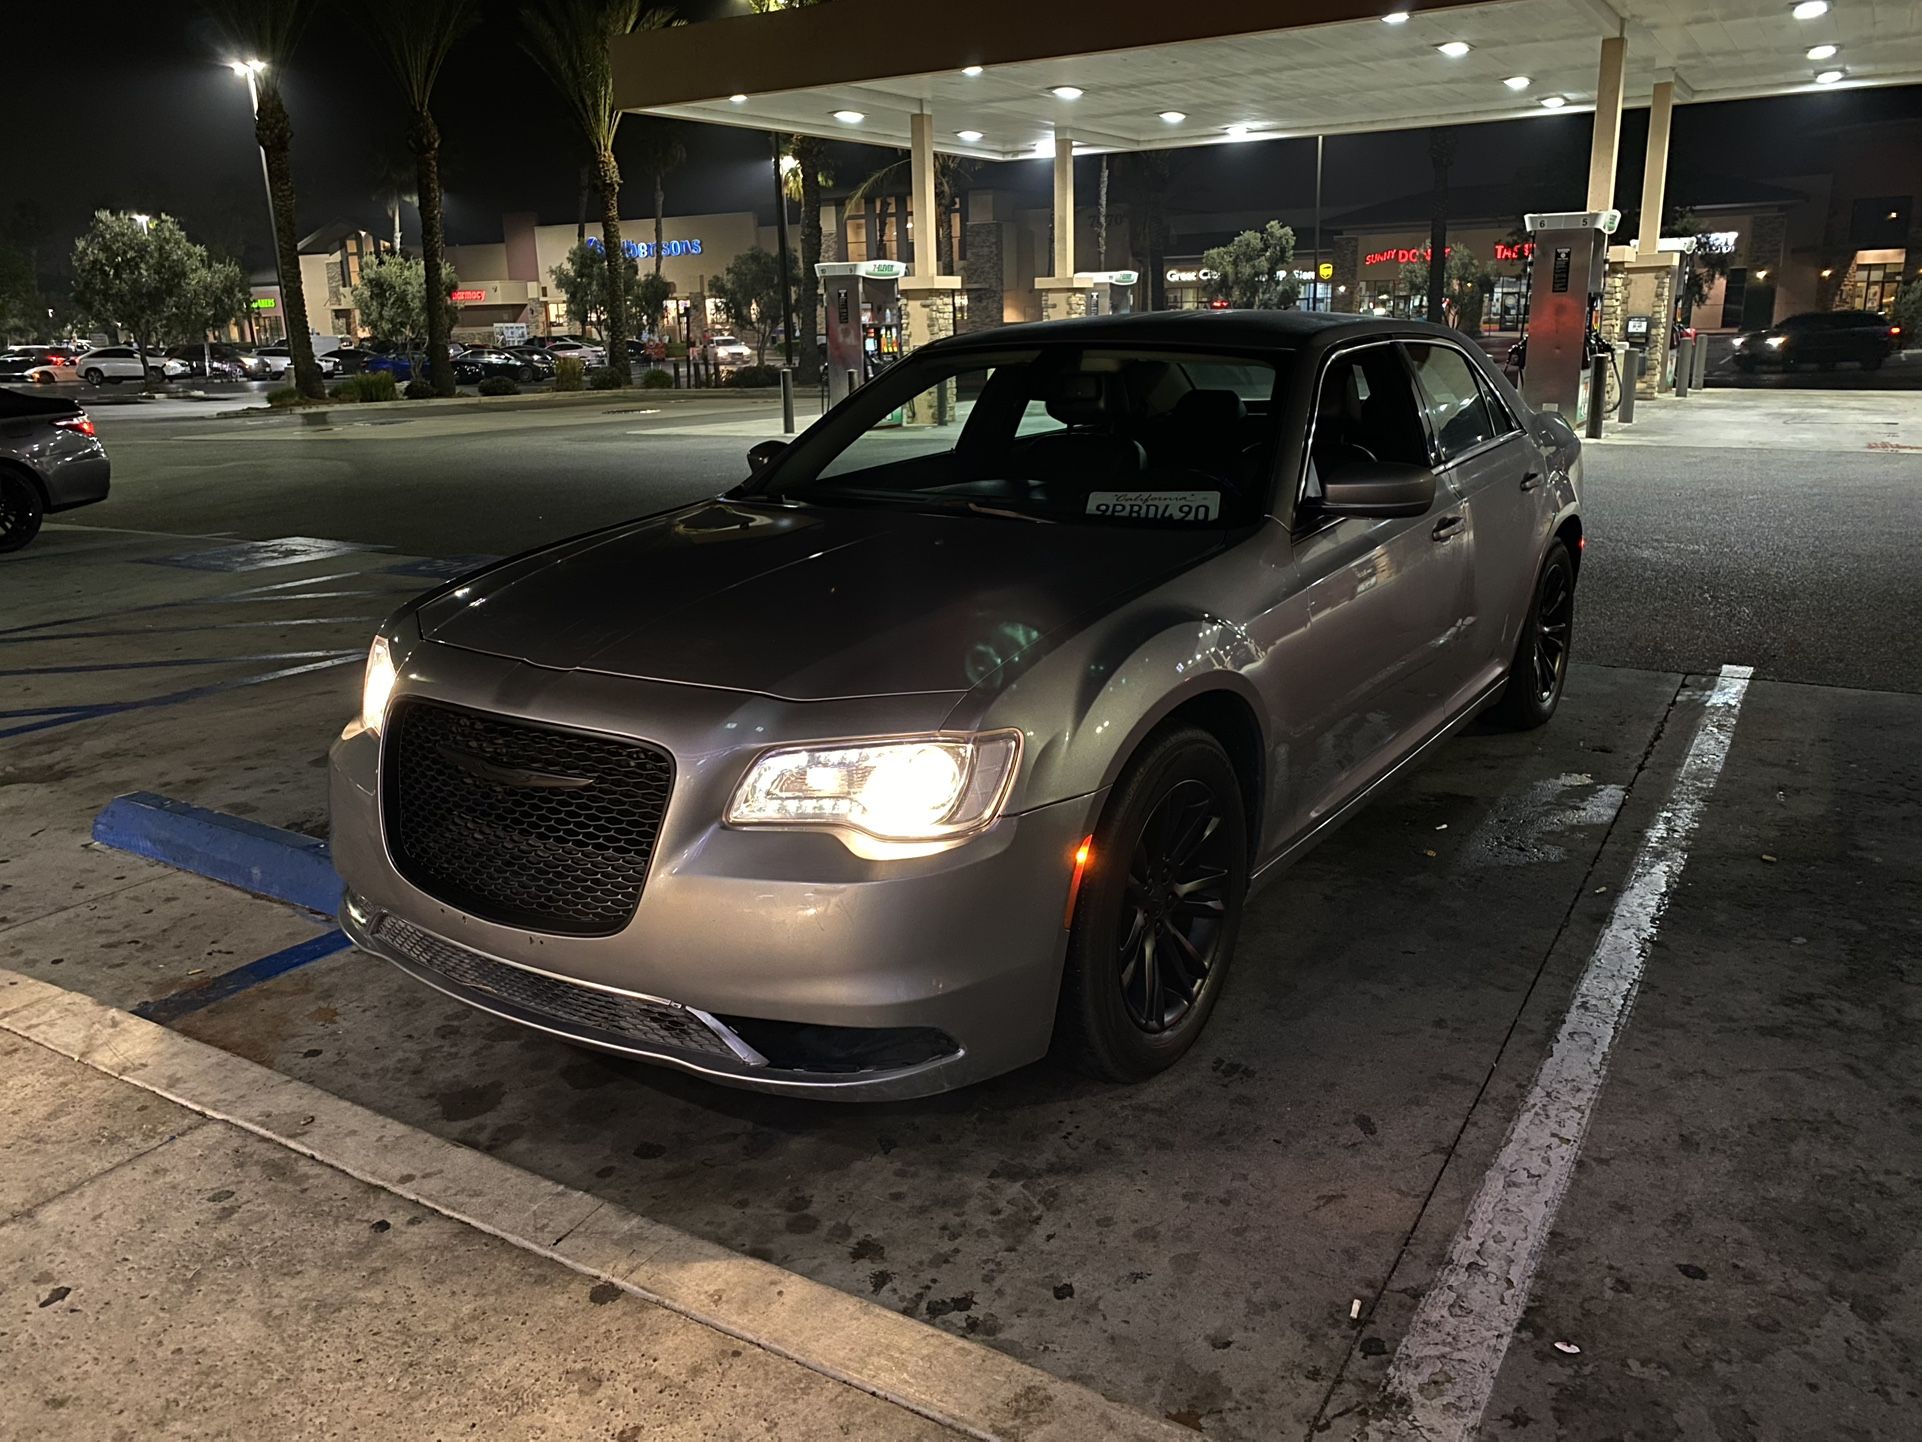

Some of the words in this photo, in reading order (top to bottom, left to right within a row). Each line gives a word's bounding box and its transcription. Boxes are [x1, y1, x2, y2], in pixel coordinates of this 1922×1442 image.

[1539, 220, 1545, 228] 6
[1582, 218, 1588, 226] 5
[1366, 249, 1396, 265] SUNNY
